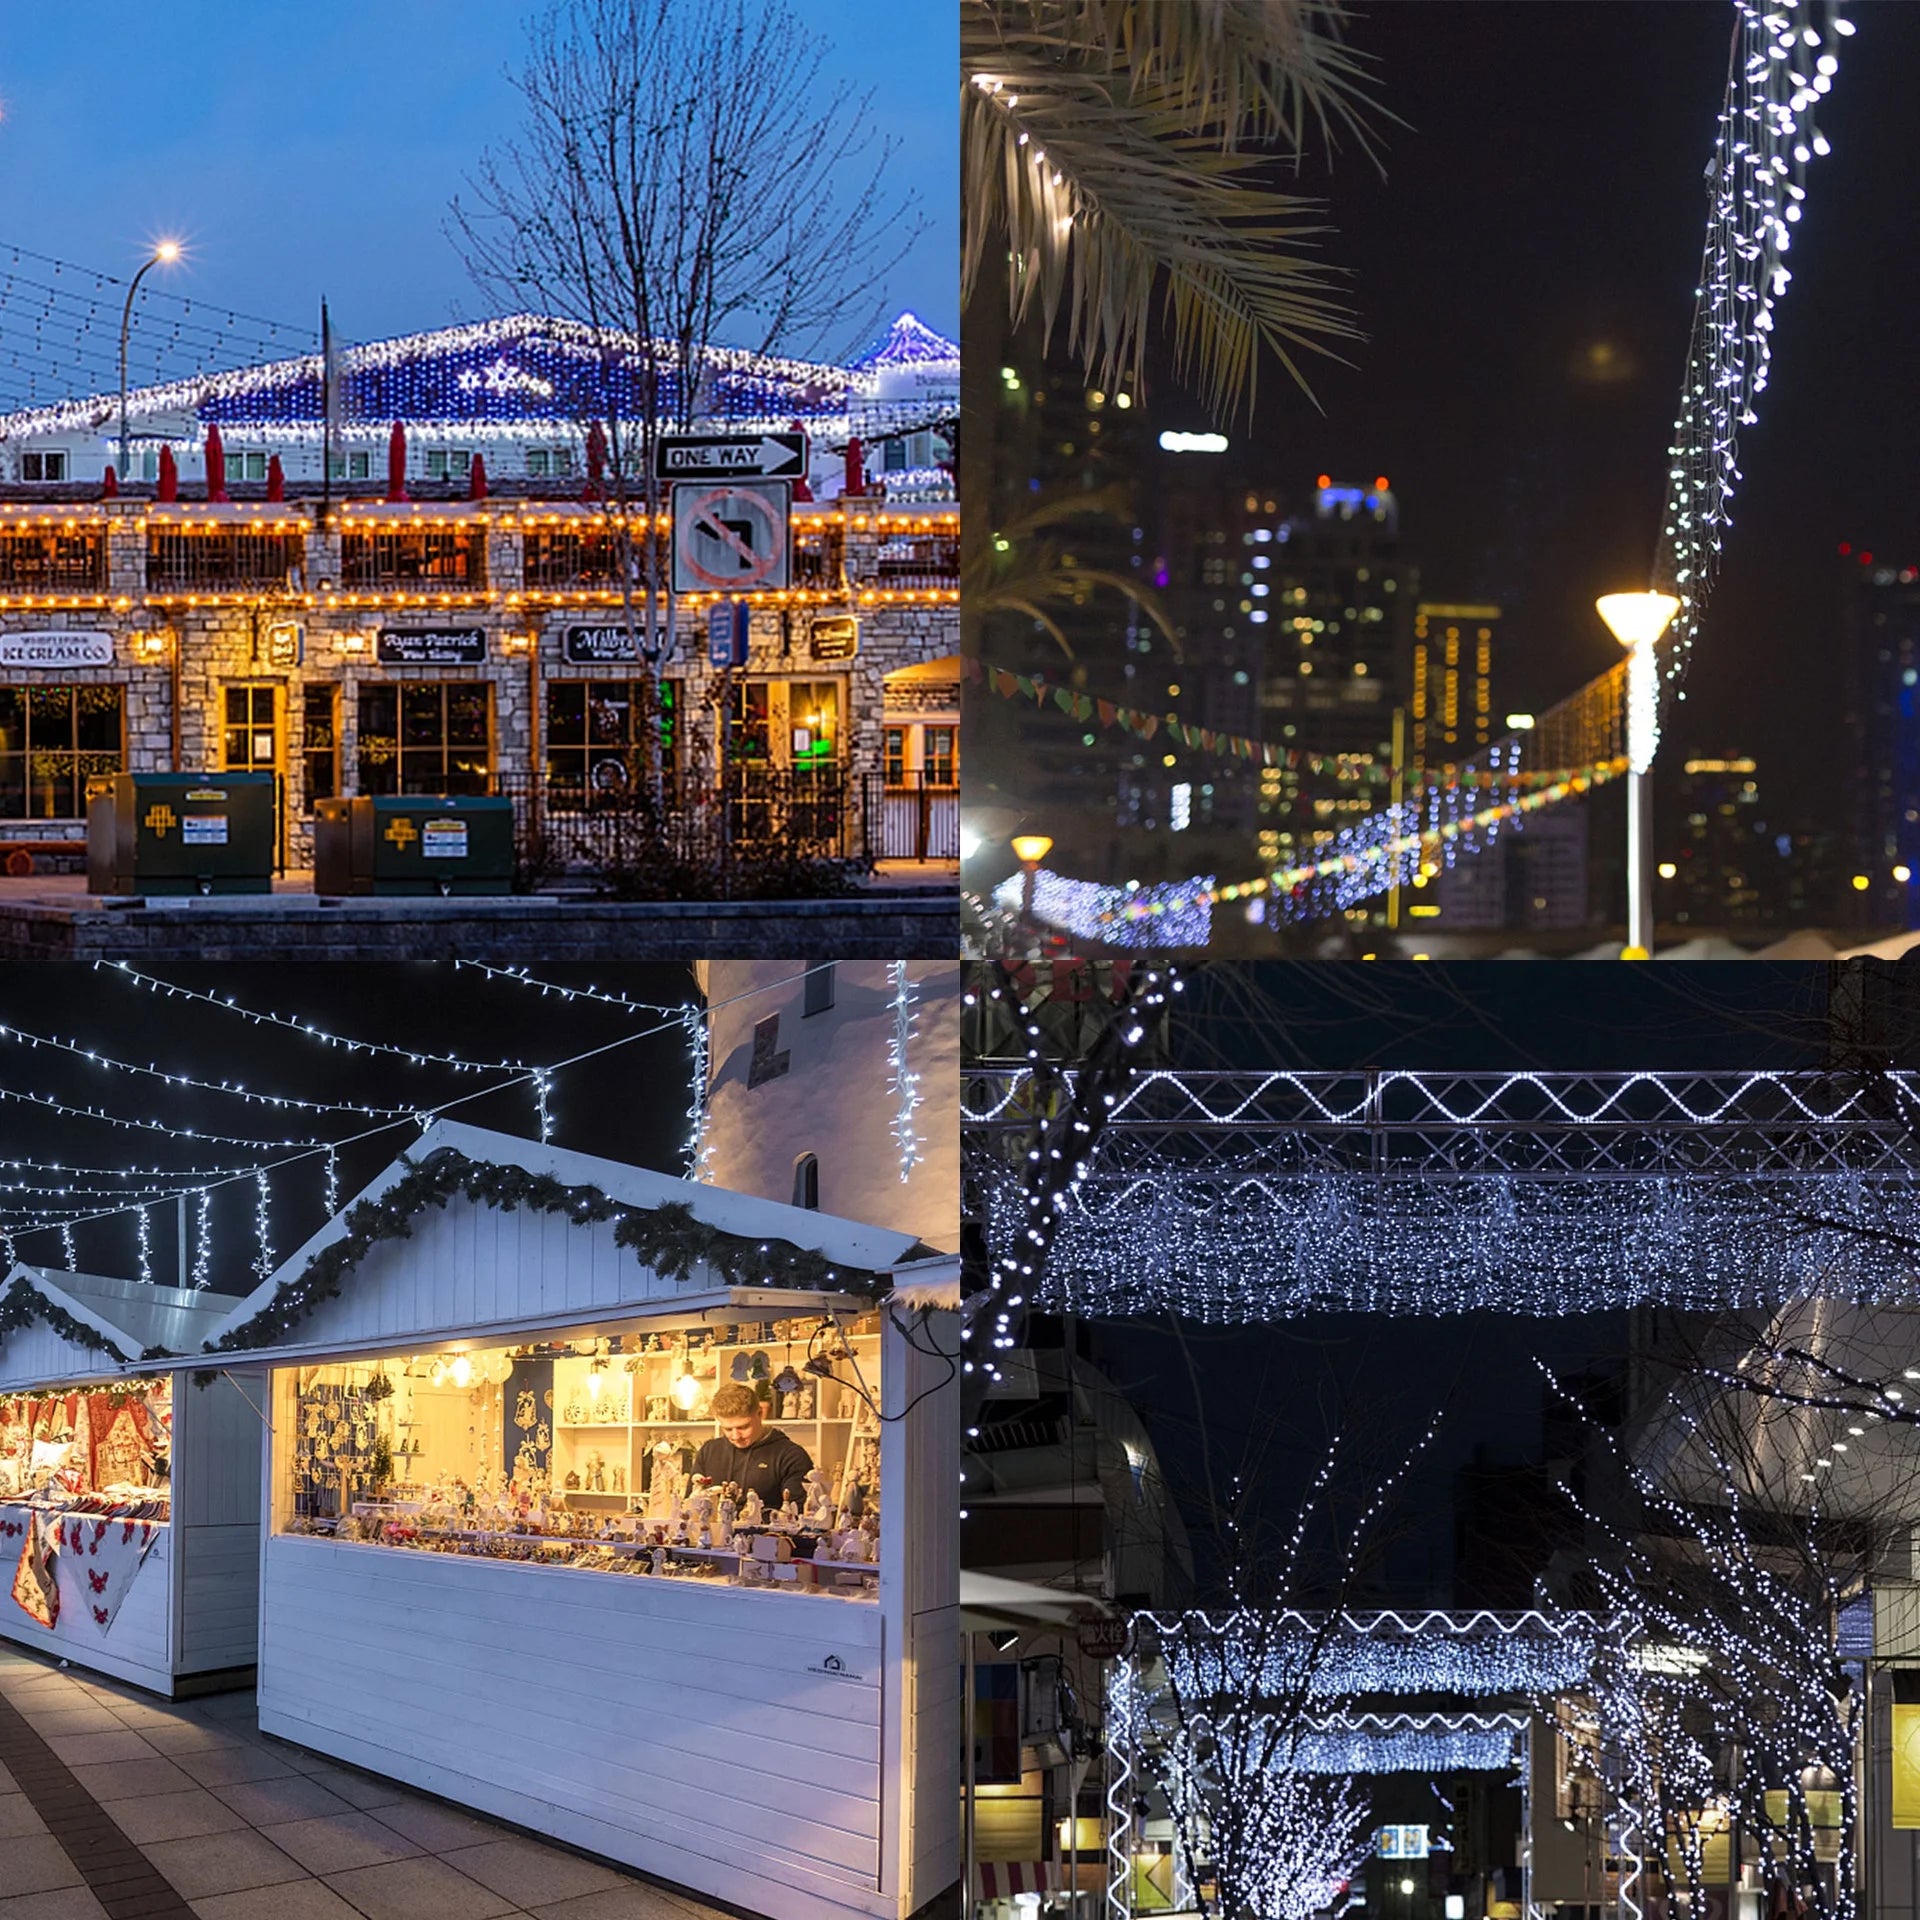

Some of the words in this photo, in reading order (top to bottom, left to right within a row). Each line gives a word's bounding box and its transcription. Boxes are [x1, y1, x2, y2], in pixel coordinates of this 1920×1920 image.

[671, 448, 712, 467] ONE
[718, 446, 760, 465] WAY
[424, 629, 479, 647] Patrick
[3, 646, 25, 660] ICE
[28, 646, 80, 660] CREAM
